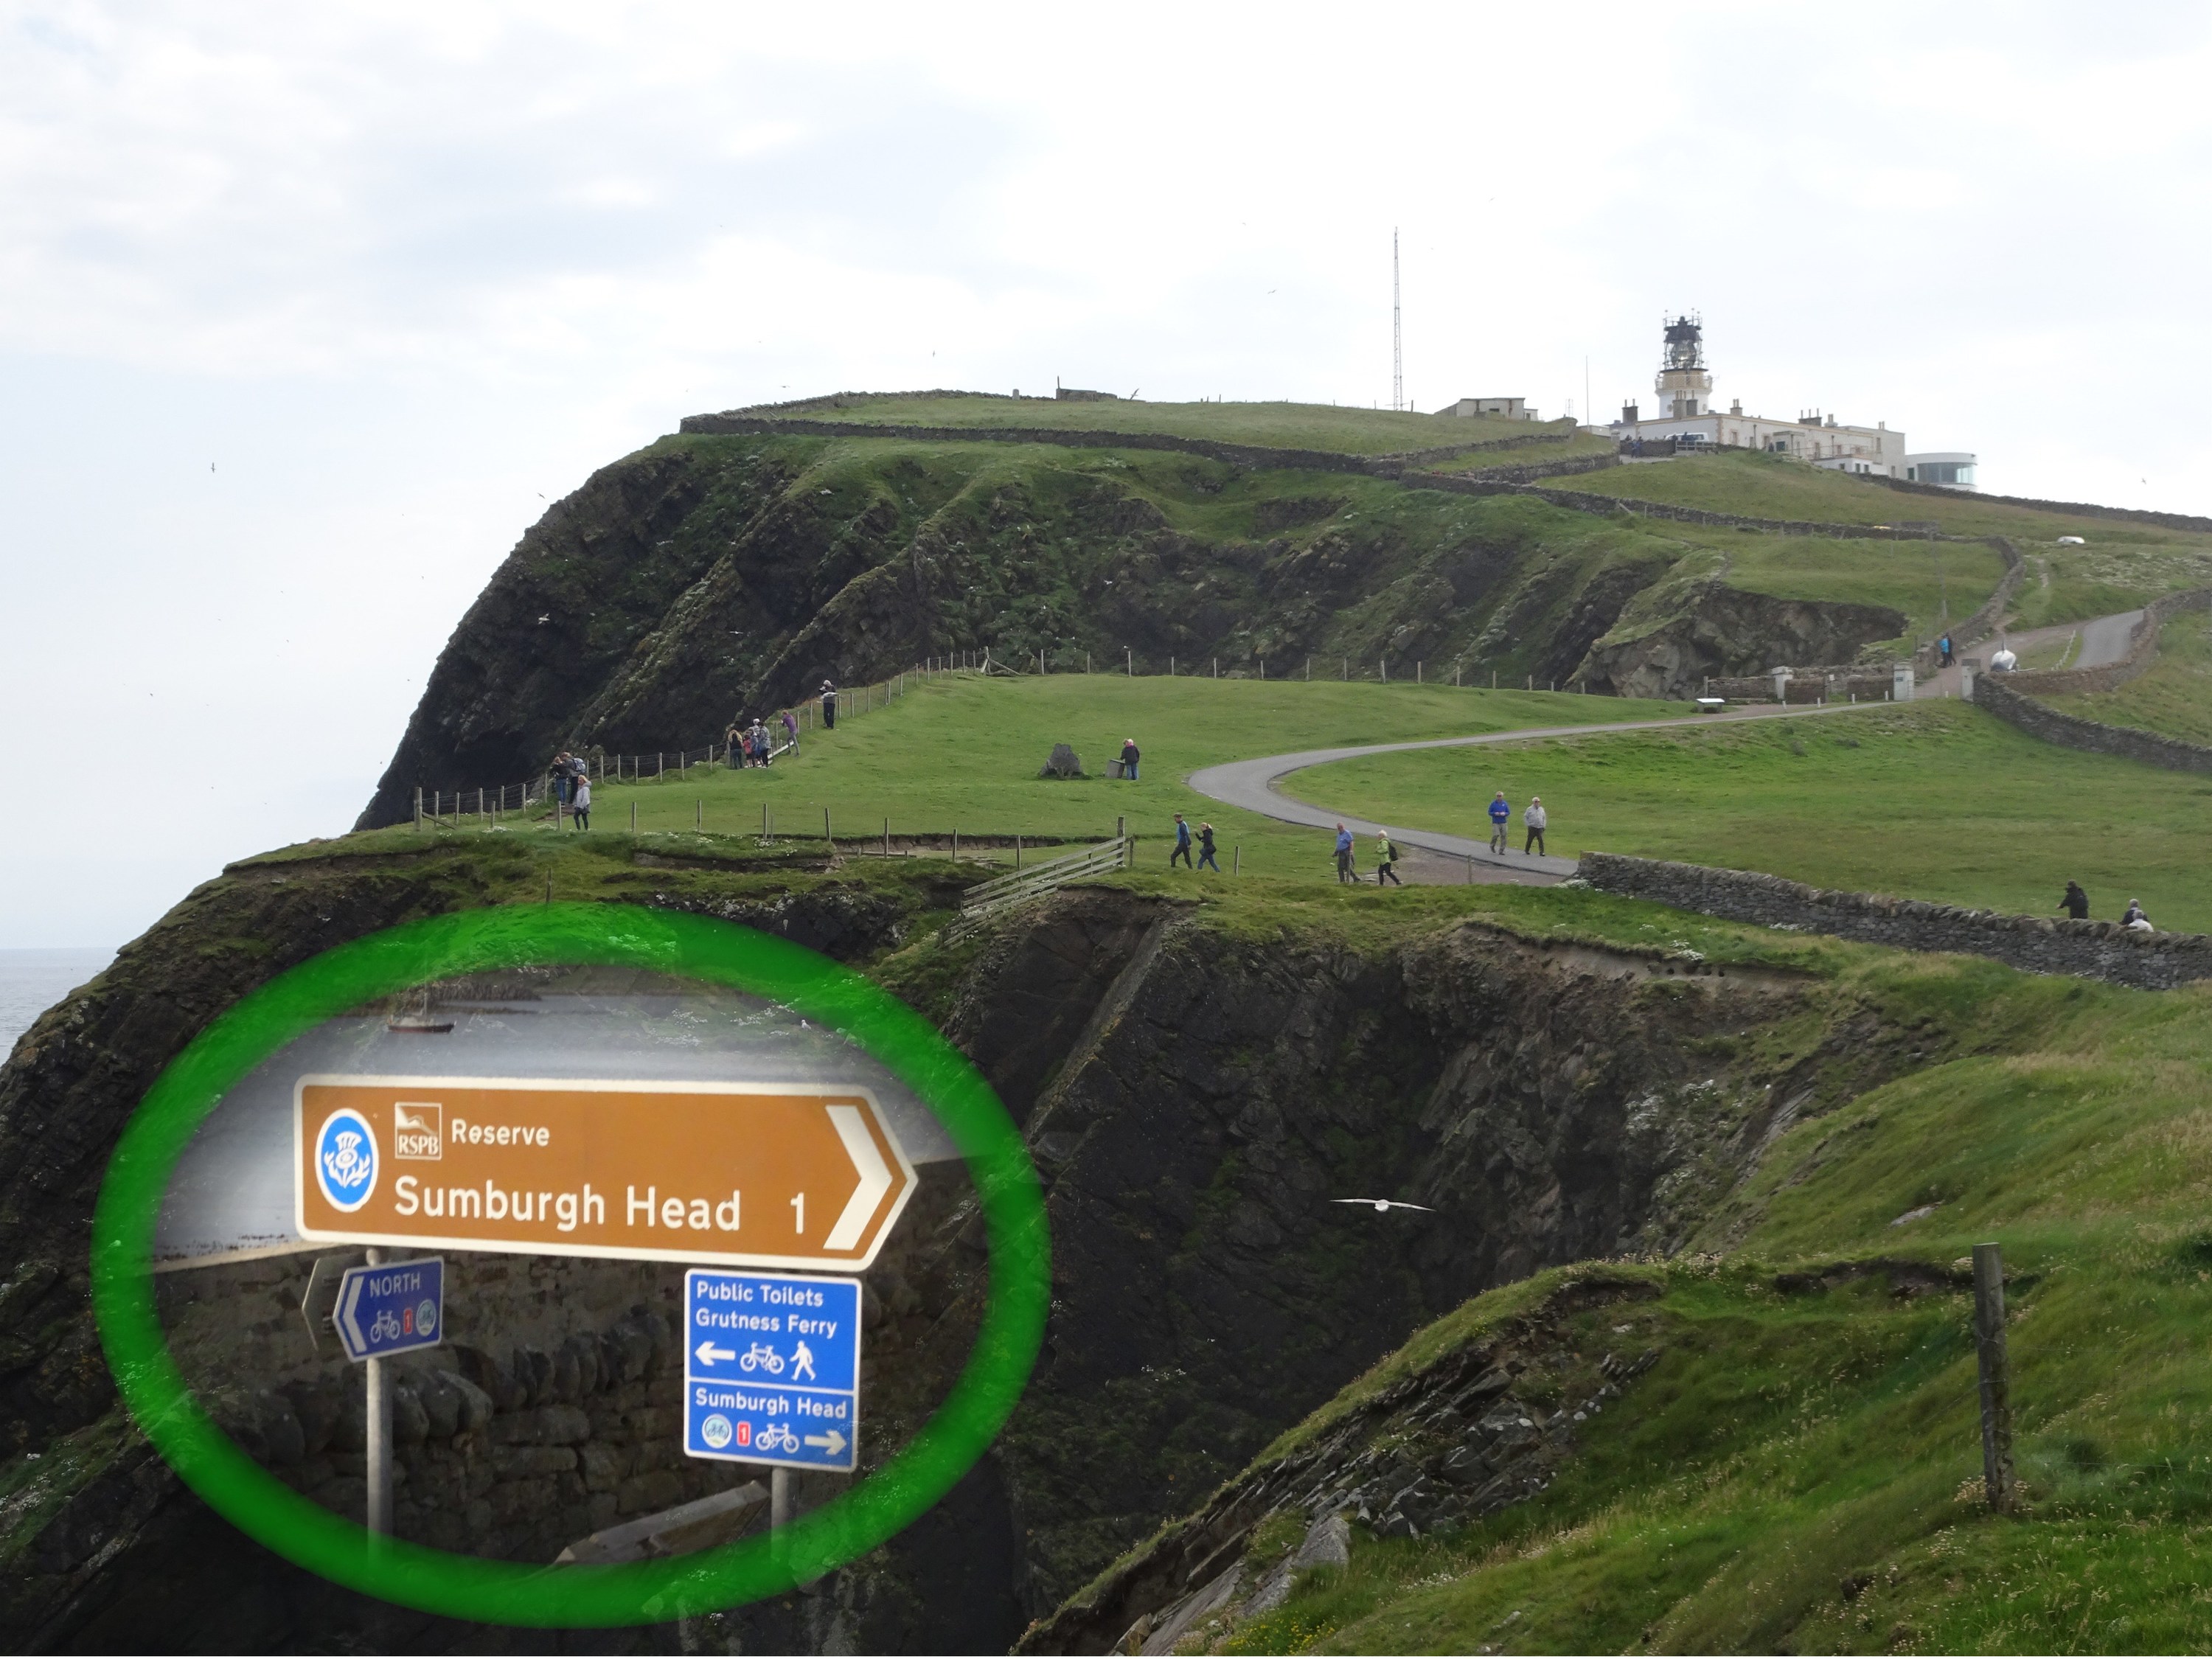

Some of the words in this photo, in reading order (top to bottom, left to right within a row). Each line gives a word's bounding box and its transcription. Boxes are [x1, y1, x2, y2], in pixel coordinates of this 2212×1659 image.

[398, 1134, 439, 1155] RSPB
[452, 1119, 549, 1147] Reserve
[394, 1175, 605, 1232] Sumburgh
[627, 1185, 740, 1231] Head
[790, 1192, 804, 1234] 1
[369, 1272, 421, 1298] NORTH
[697, 1280, 754, 1302] Public
[760, 1284, 824, 1307] Toilets
[695, 1307, 780, 1332] Grutness
[787, 1314, 838, 1340] Ferry
[695, 1387, 790, 1416] Sumburgh
[797, 1397, 846, 1419] Head
